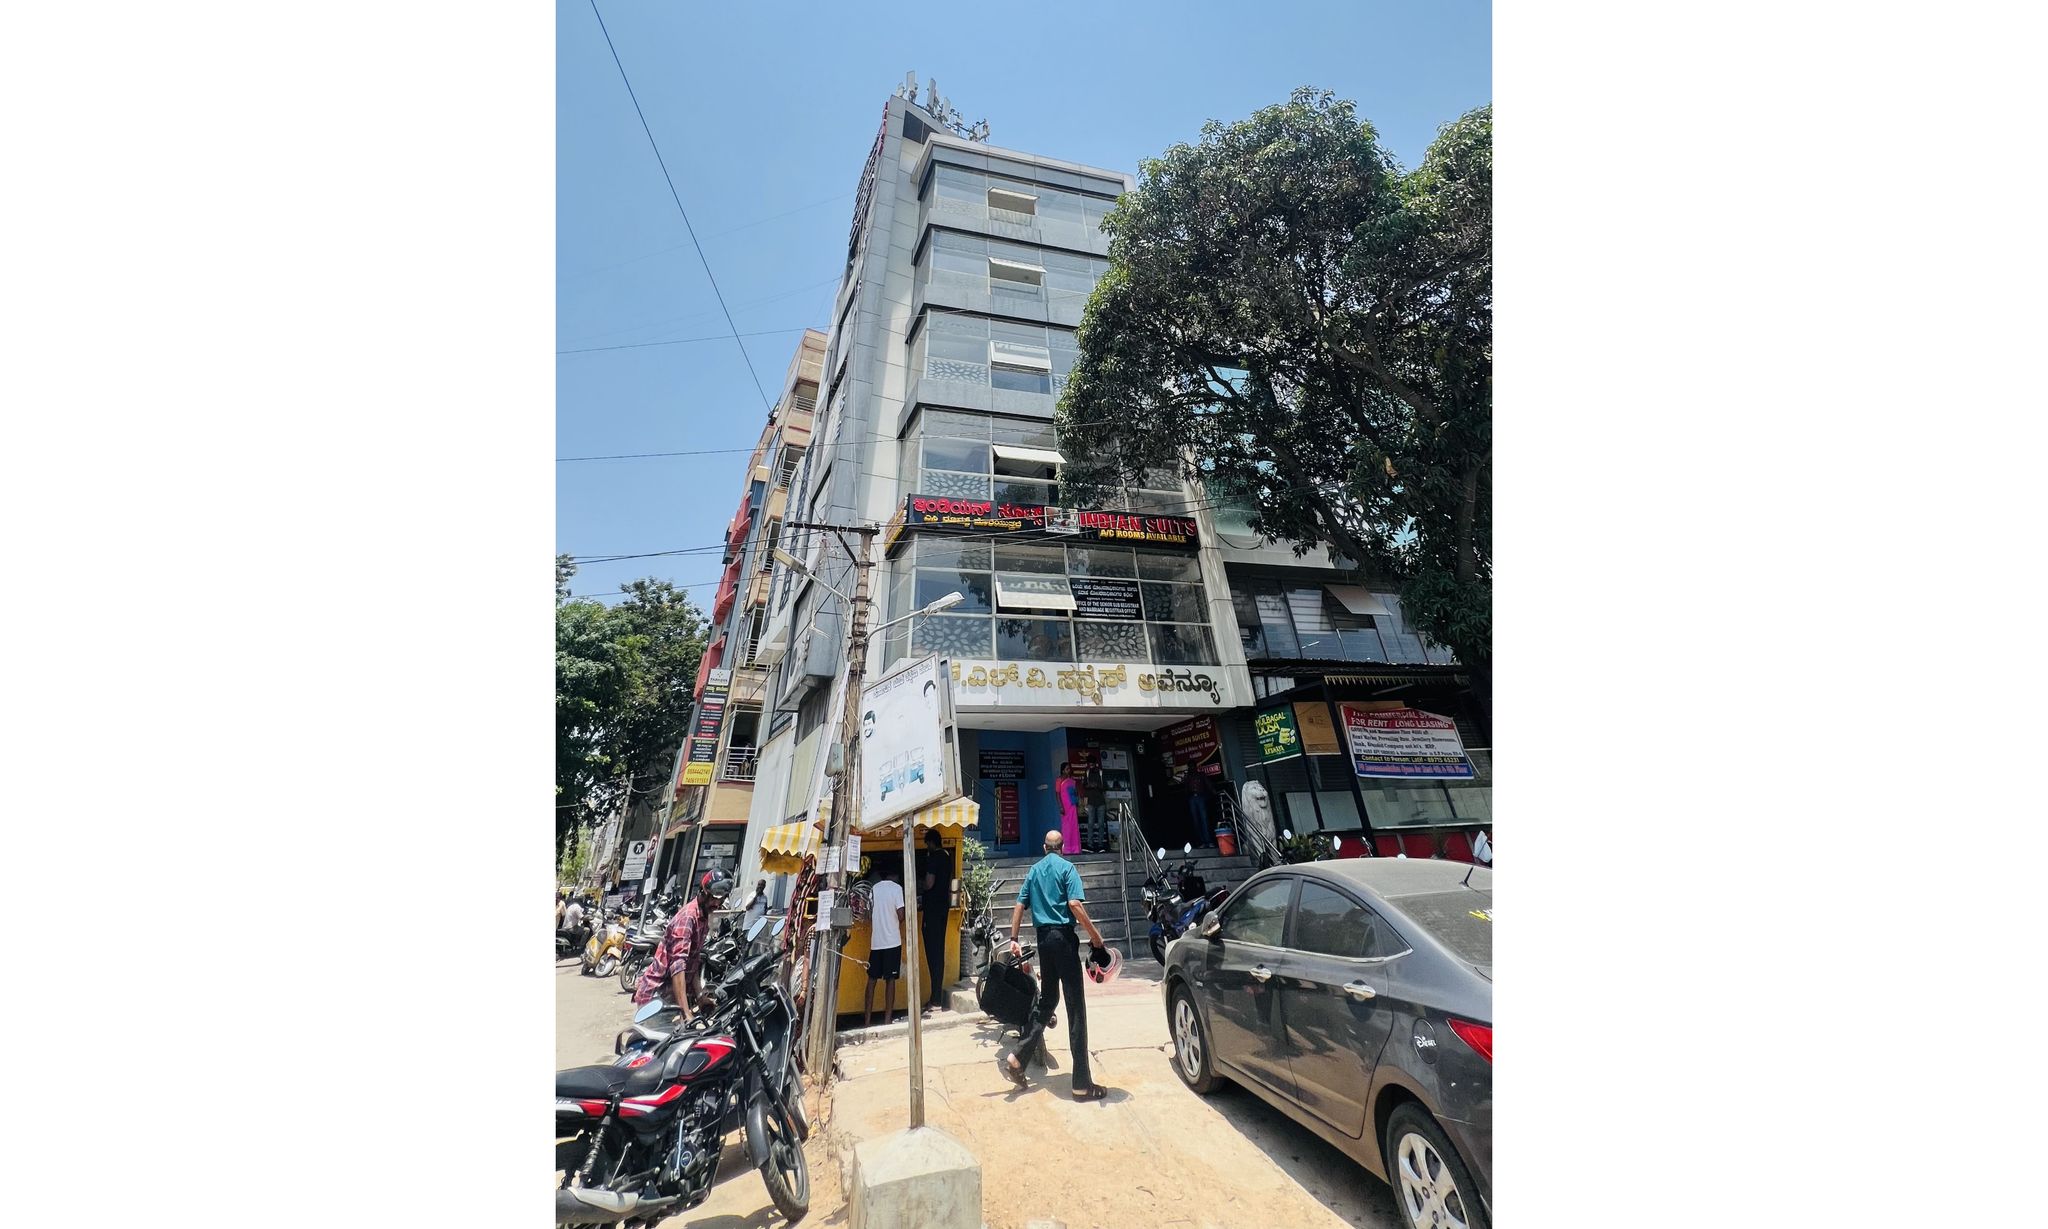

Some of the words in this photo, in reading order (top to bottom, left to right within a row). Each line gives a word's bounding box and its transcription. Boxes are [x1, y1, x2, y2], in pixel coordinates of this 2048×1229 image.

[1079, 512, 1142, 532] INDIAN
[1146, 517, 1196, 537] SUITS
[1100, 529, 1115, 538] A/C
[1116, 529, 1146, 540] ROOMS
[1146, 532, 1188, 543] AVAILABLE
[1255, 712, 1287, 727] MULBAGAL
[1351, 717, 1366, 726] FOR
[1367, 719, 1389, 727] RENT
[1395, 720, 1415, 728] LONG
[1257, 722, 1280, 736] DOSA
[1192, 731, 1210, 742] SUITES
